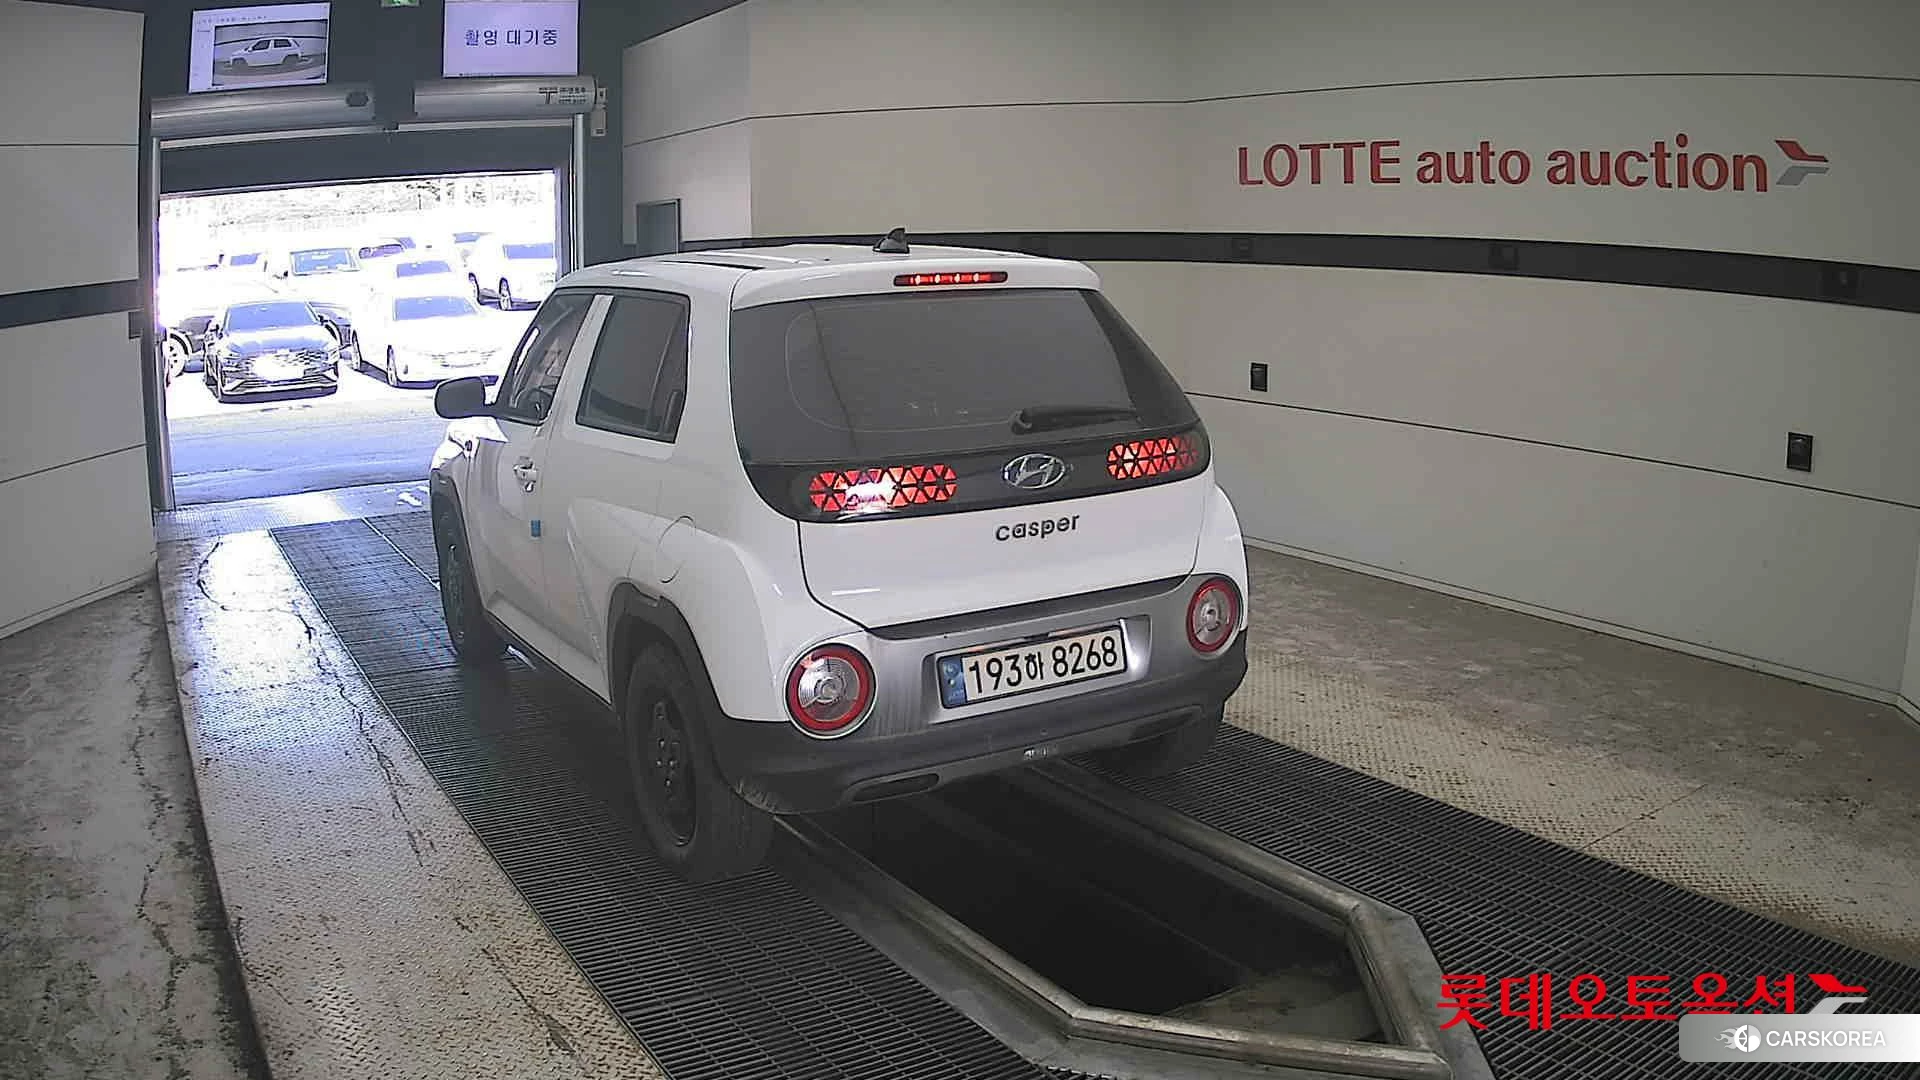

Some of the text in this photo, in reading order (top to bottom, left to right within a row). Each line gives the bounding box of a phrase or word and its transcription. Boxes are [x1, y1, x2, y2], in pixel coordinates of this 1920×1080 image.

[465, 29, 558, 46] 촬영 대기중
[1238, 133, 1767, 192] LOTTE auto auction
[996, 514, 1080, 541] casper
[968, 635, 1118, 694] 193하 8268
